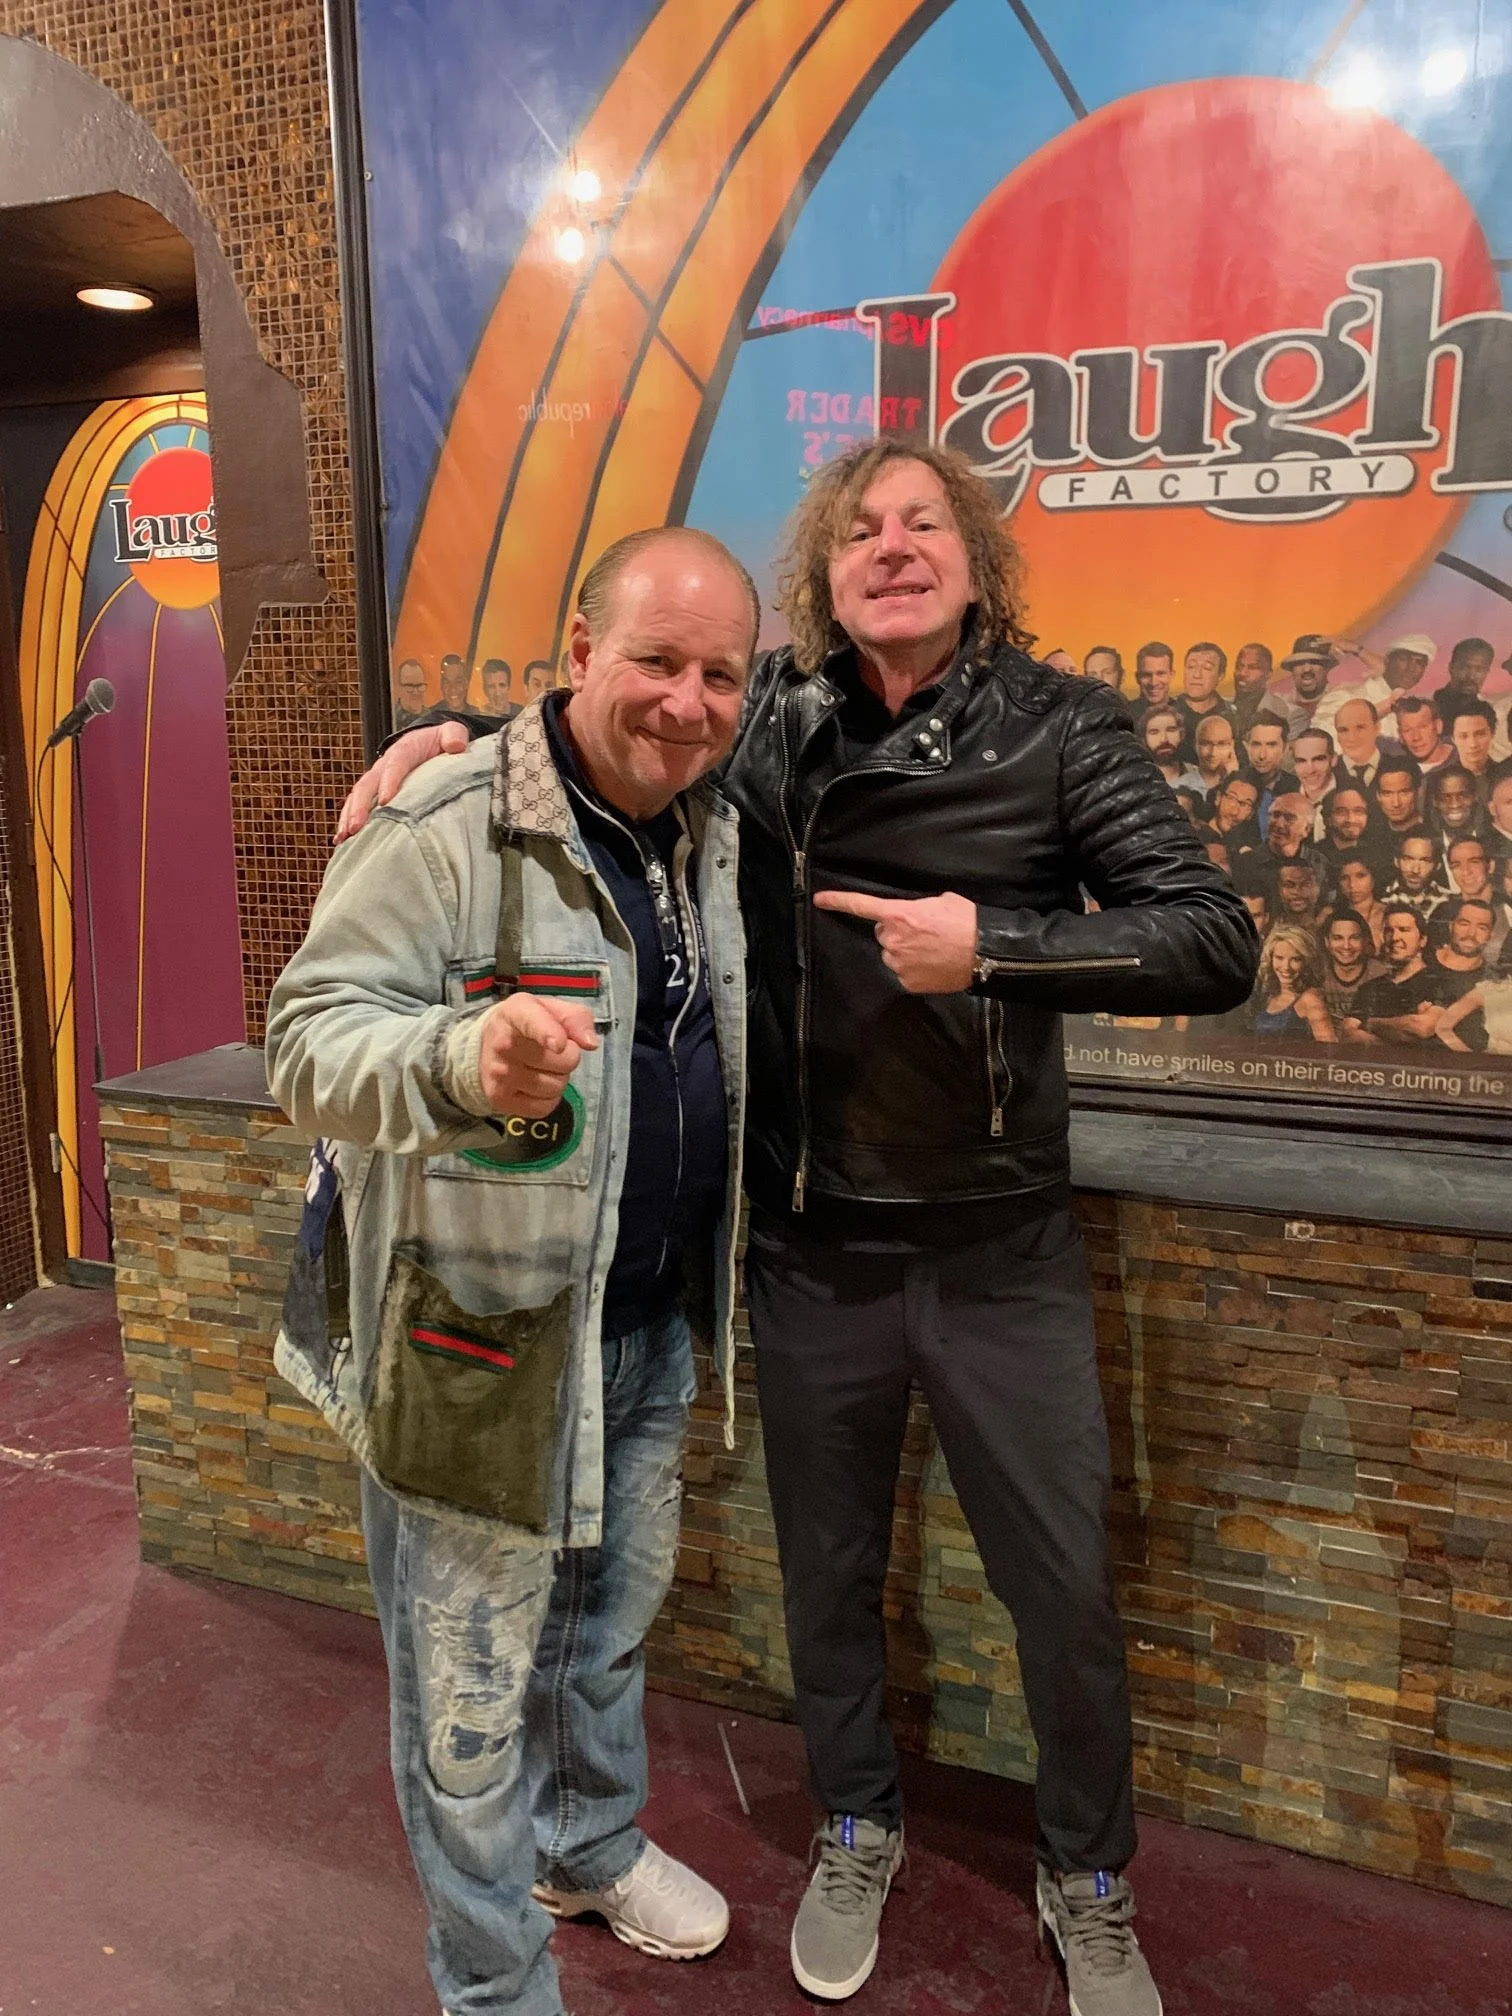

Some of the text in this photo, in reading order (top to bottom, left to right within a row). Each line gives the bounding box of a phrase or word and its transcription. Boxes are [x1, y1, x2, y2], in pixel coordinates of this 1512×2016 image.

[856, 256, 1512, 522] Laugh
[1068, 462, 1386, 503] FACTORY
[109, 496, 217, 562] Laug
[160, 547, 217, 556] FACTOR
[1079, 1047, 1110, 1063] not
[1116, 1047, 1165, 1067] have
[1170, 1054, 1235, 1073] smiles
[1241, 1060, 1268, 1078] on
[1274, 1060, 1321, 1081] their
[1327, 1064, 1386, 1086] faces
[1391, 1069, 1461, 1096] during
[1469, 1075, 1505, 1095] the
[507, 1117, 559, 1141] CCI
